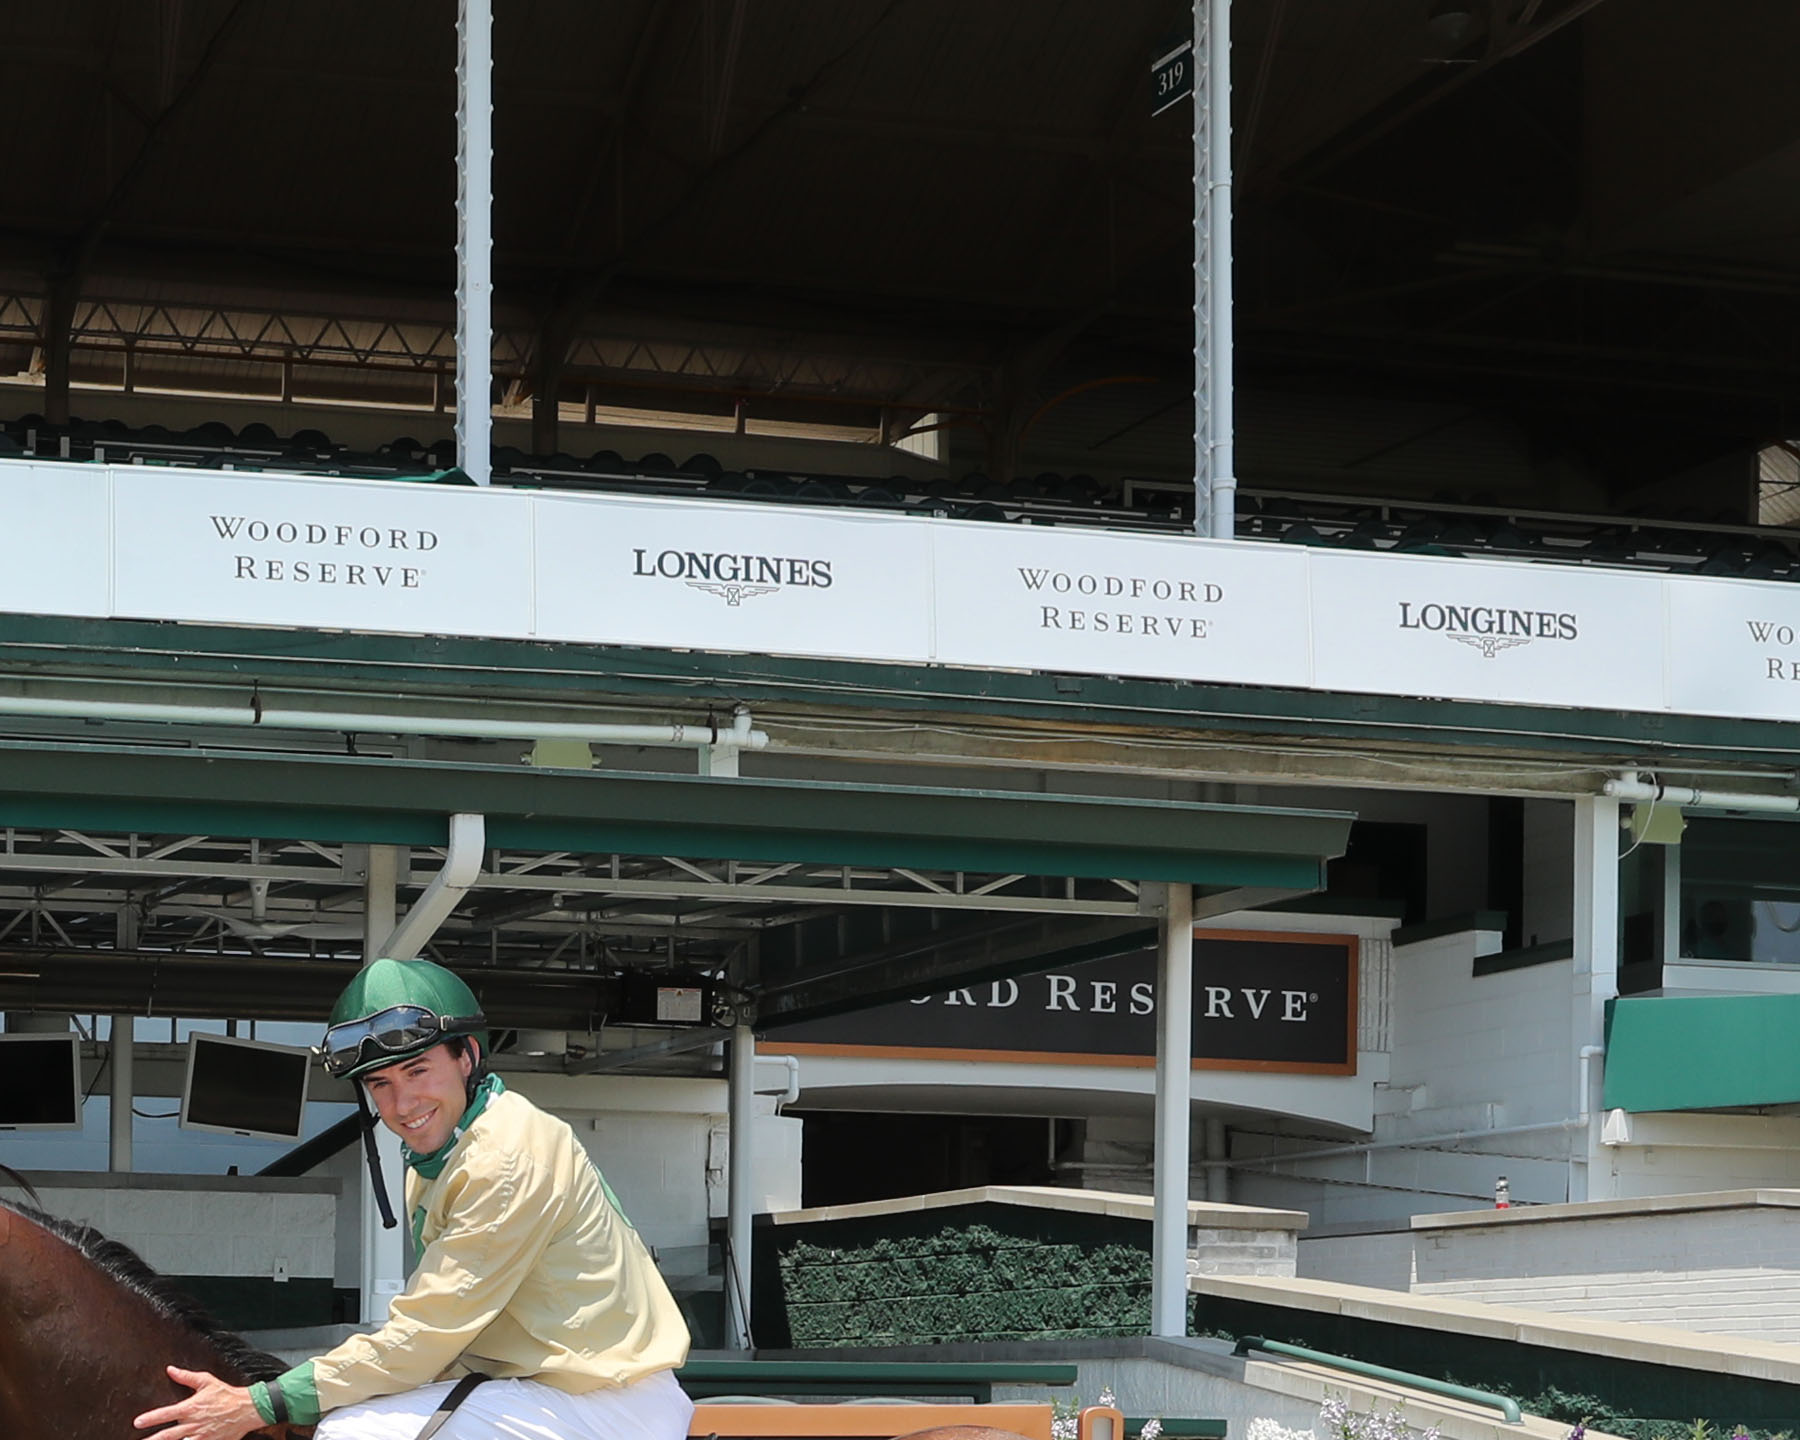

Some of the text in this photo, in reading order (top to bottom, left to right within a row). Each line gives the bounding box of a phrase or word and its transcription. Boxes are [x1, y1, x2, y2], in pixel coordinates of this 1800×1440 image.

[1158, 61, 1184, 96] 319
[210, 515, 439, 552] WOODFORD
[234, 555, 420, 588] RESERVE
[632, 548, 833, 588] LONGINES
[1018, 567, 1224, 603] WOODFORD
[1041, 606, 1208, 639] RESERVE
[1398, 602, 1578, 641] LONGINES
